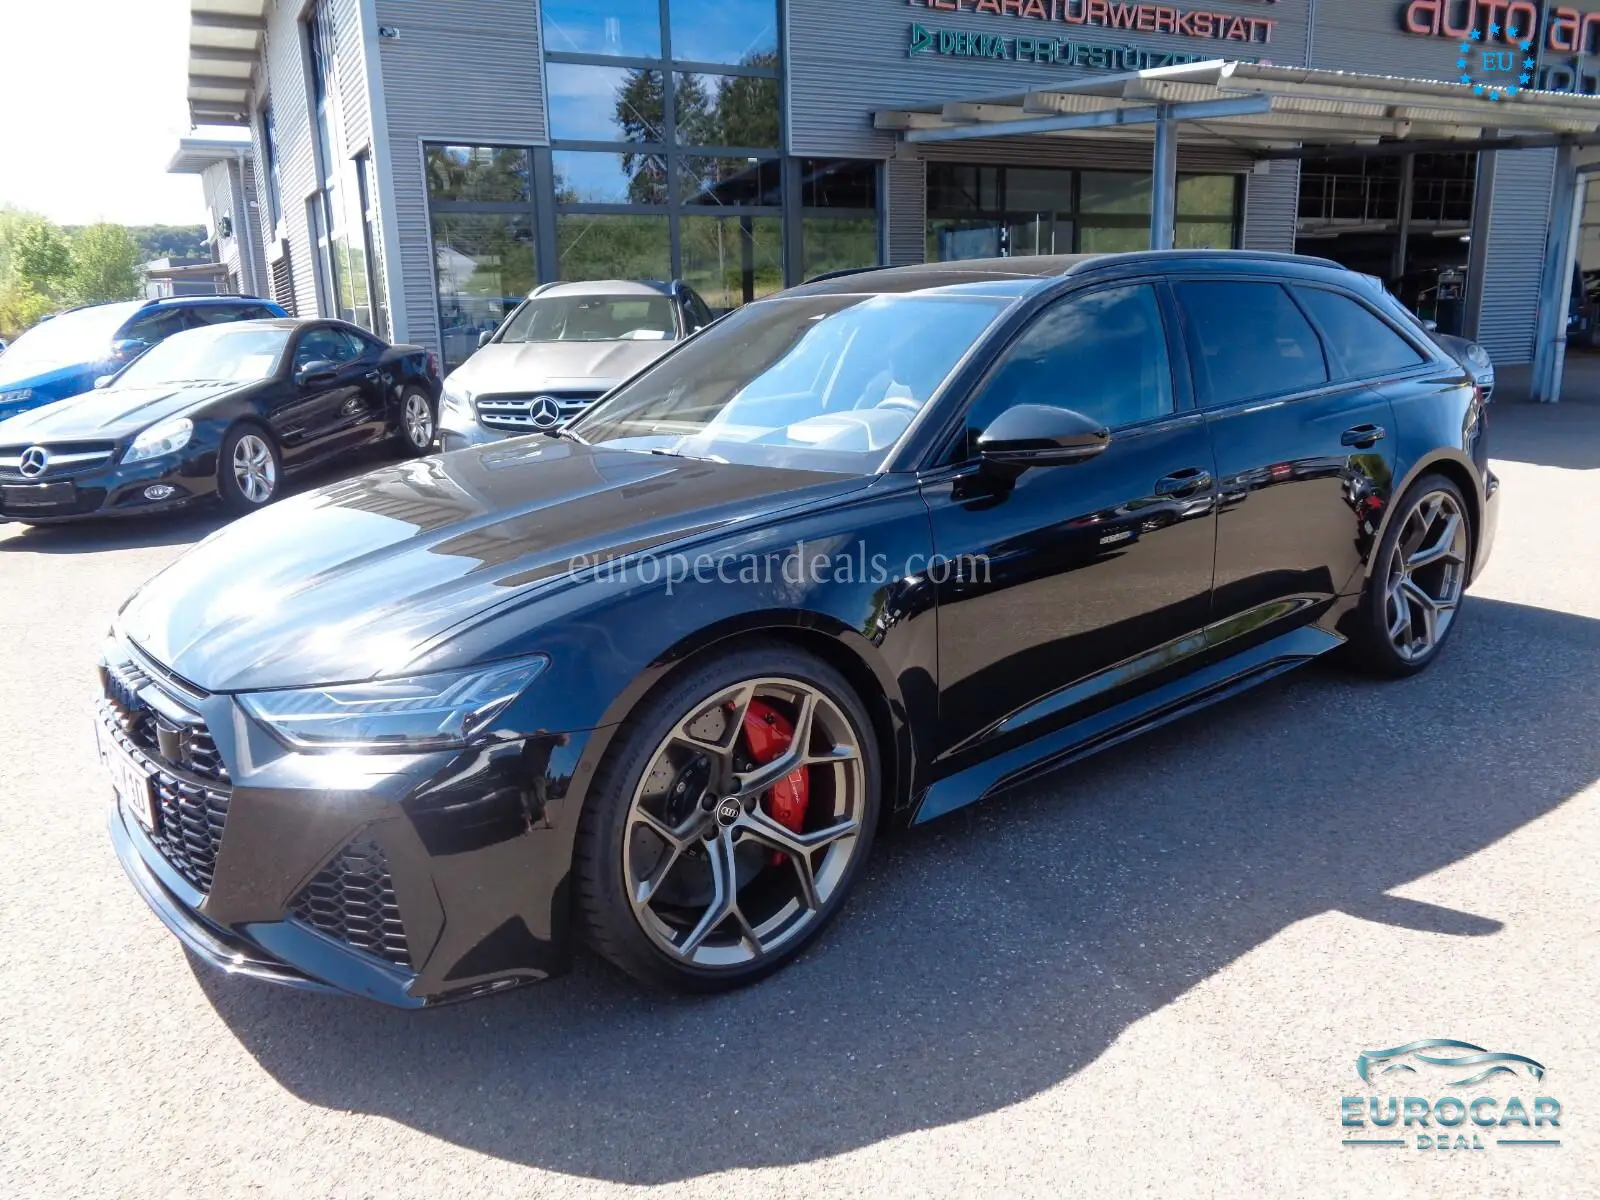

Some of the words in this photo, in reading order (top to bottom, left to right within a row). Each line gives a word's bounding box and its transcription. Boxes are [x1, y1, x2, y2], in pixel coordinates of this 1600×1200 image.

[909, 0, 1278, 43] ARATURWERKSTATT
[1407, 0, 1537, 45] auto
[939, 27, 1009, 60] DEKRA
